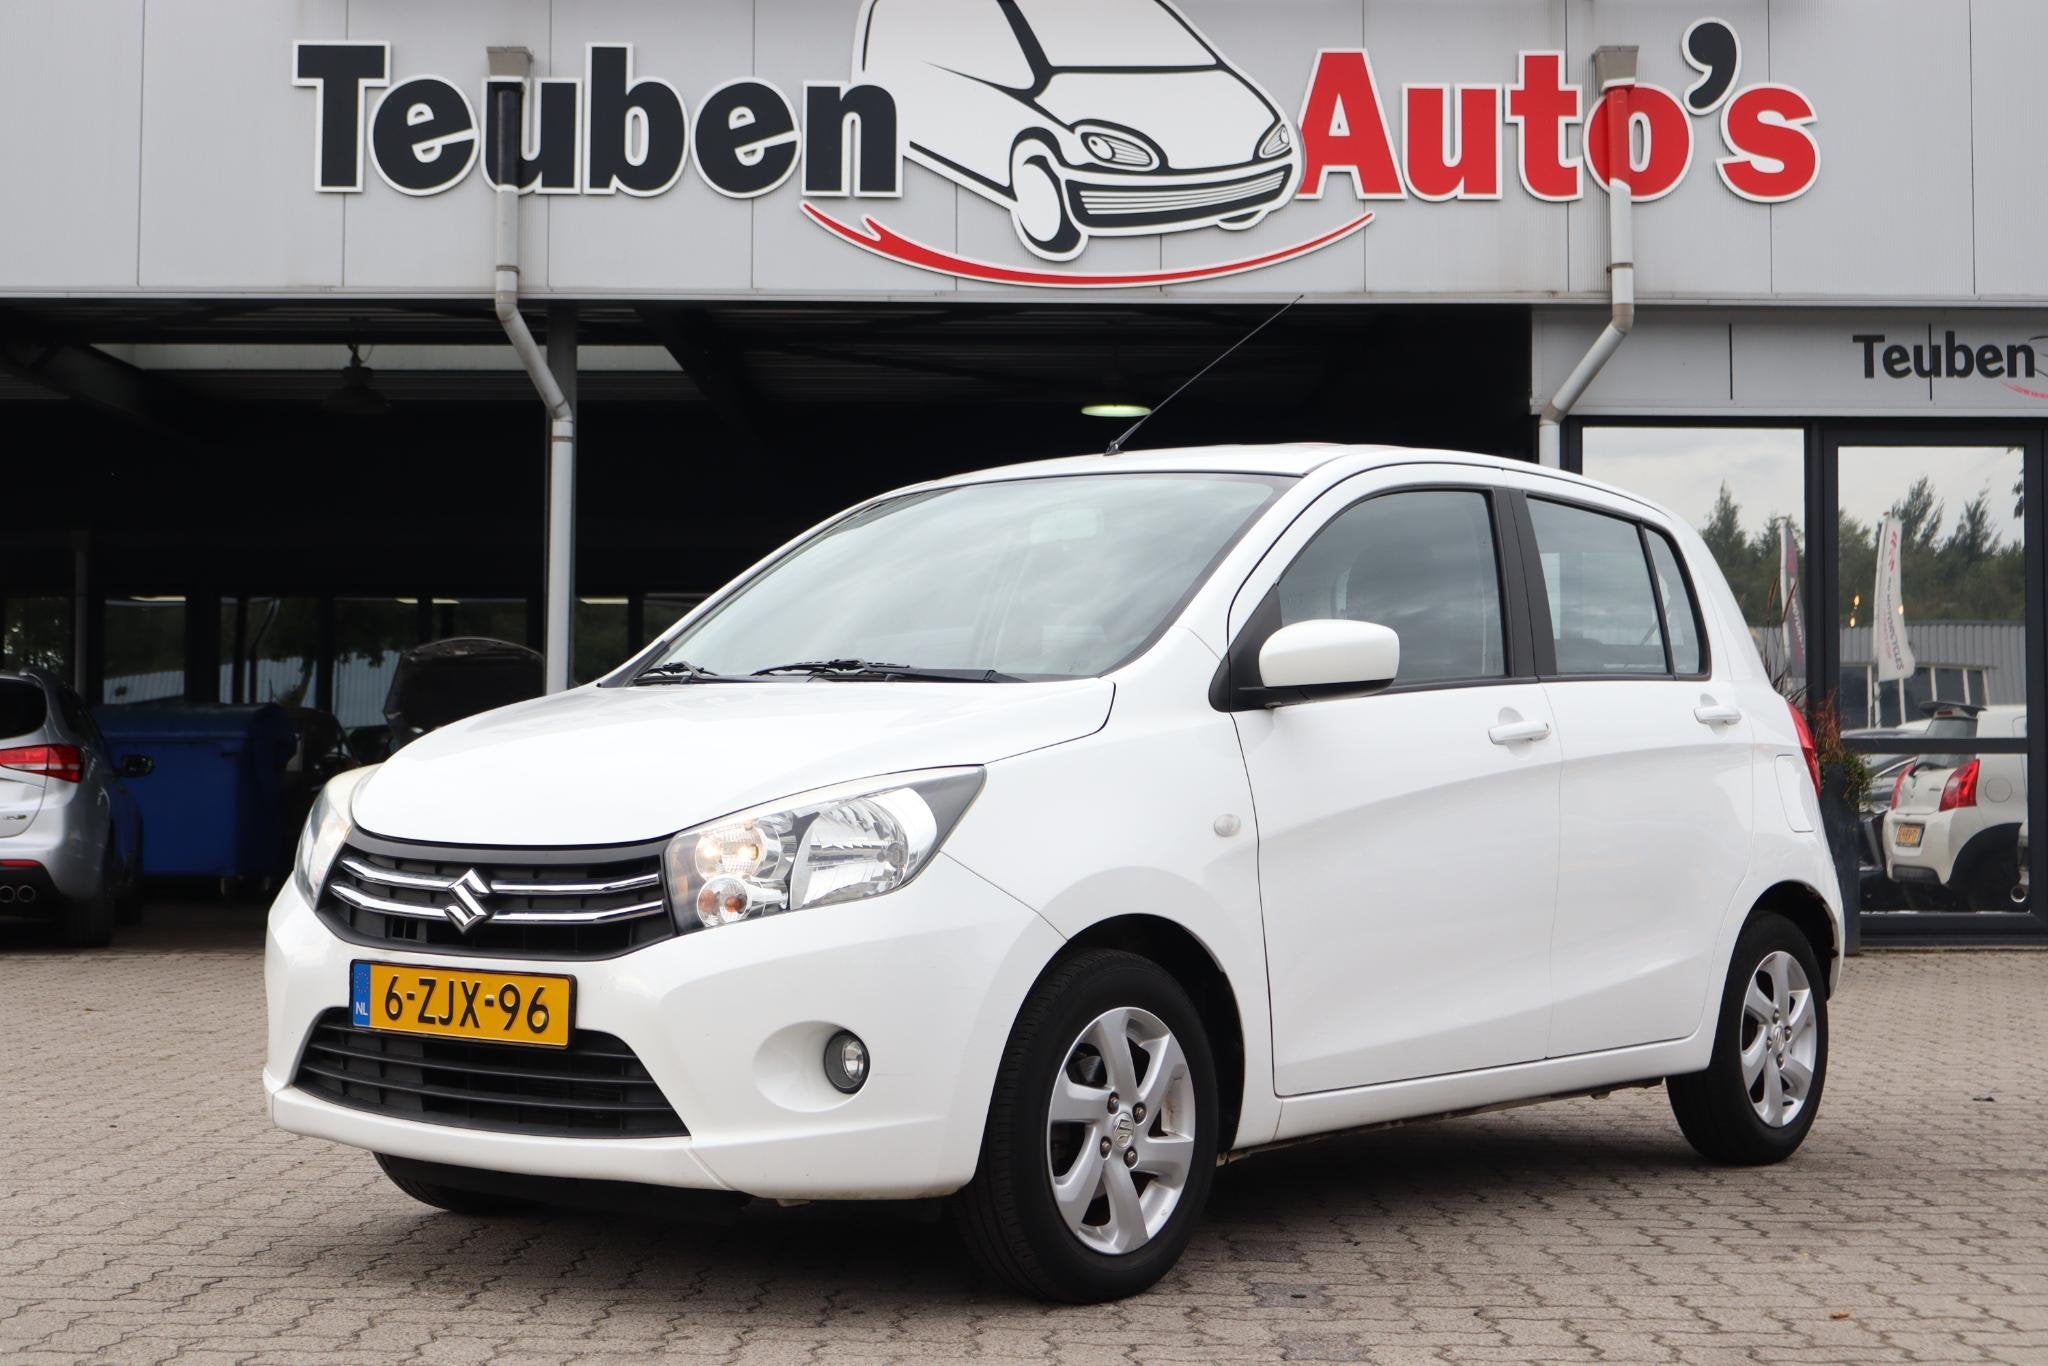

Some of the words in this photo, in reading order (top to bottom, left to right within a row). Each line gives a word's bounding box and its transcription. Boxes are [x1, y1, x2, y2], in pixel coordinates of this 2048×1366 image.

[292, 40, 904, 198] Teuben
[1296, 18, 1821, 203] Auto's
[1852, 331, 2035, 379] Teuben
[355, 1002, 368, 1016] NL
[384, 975, 549, 1034] 6-ZJX-96
